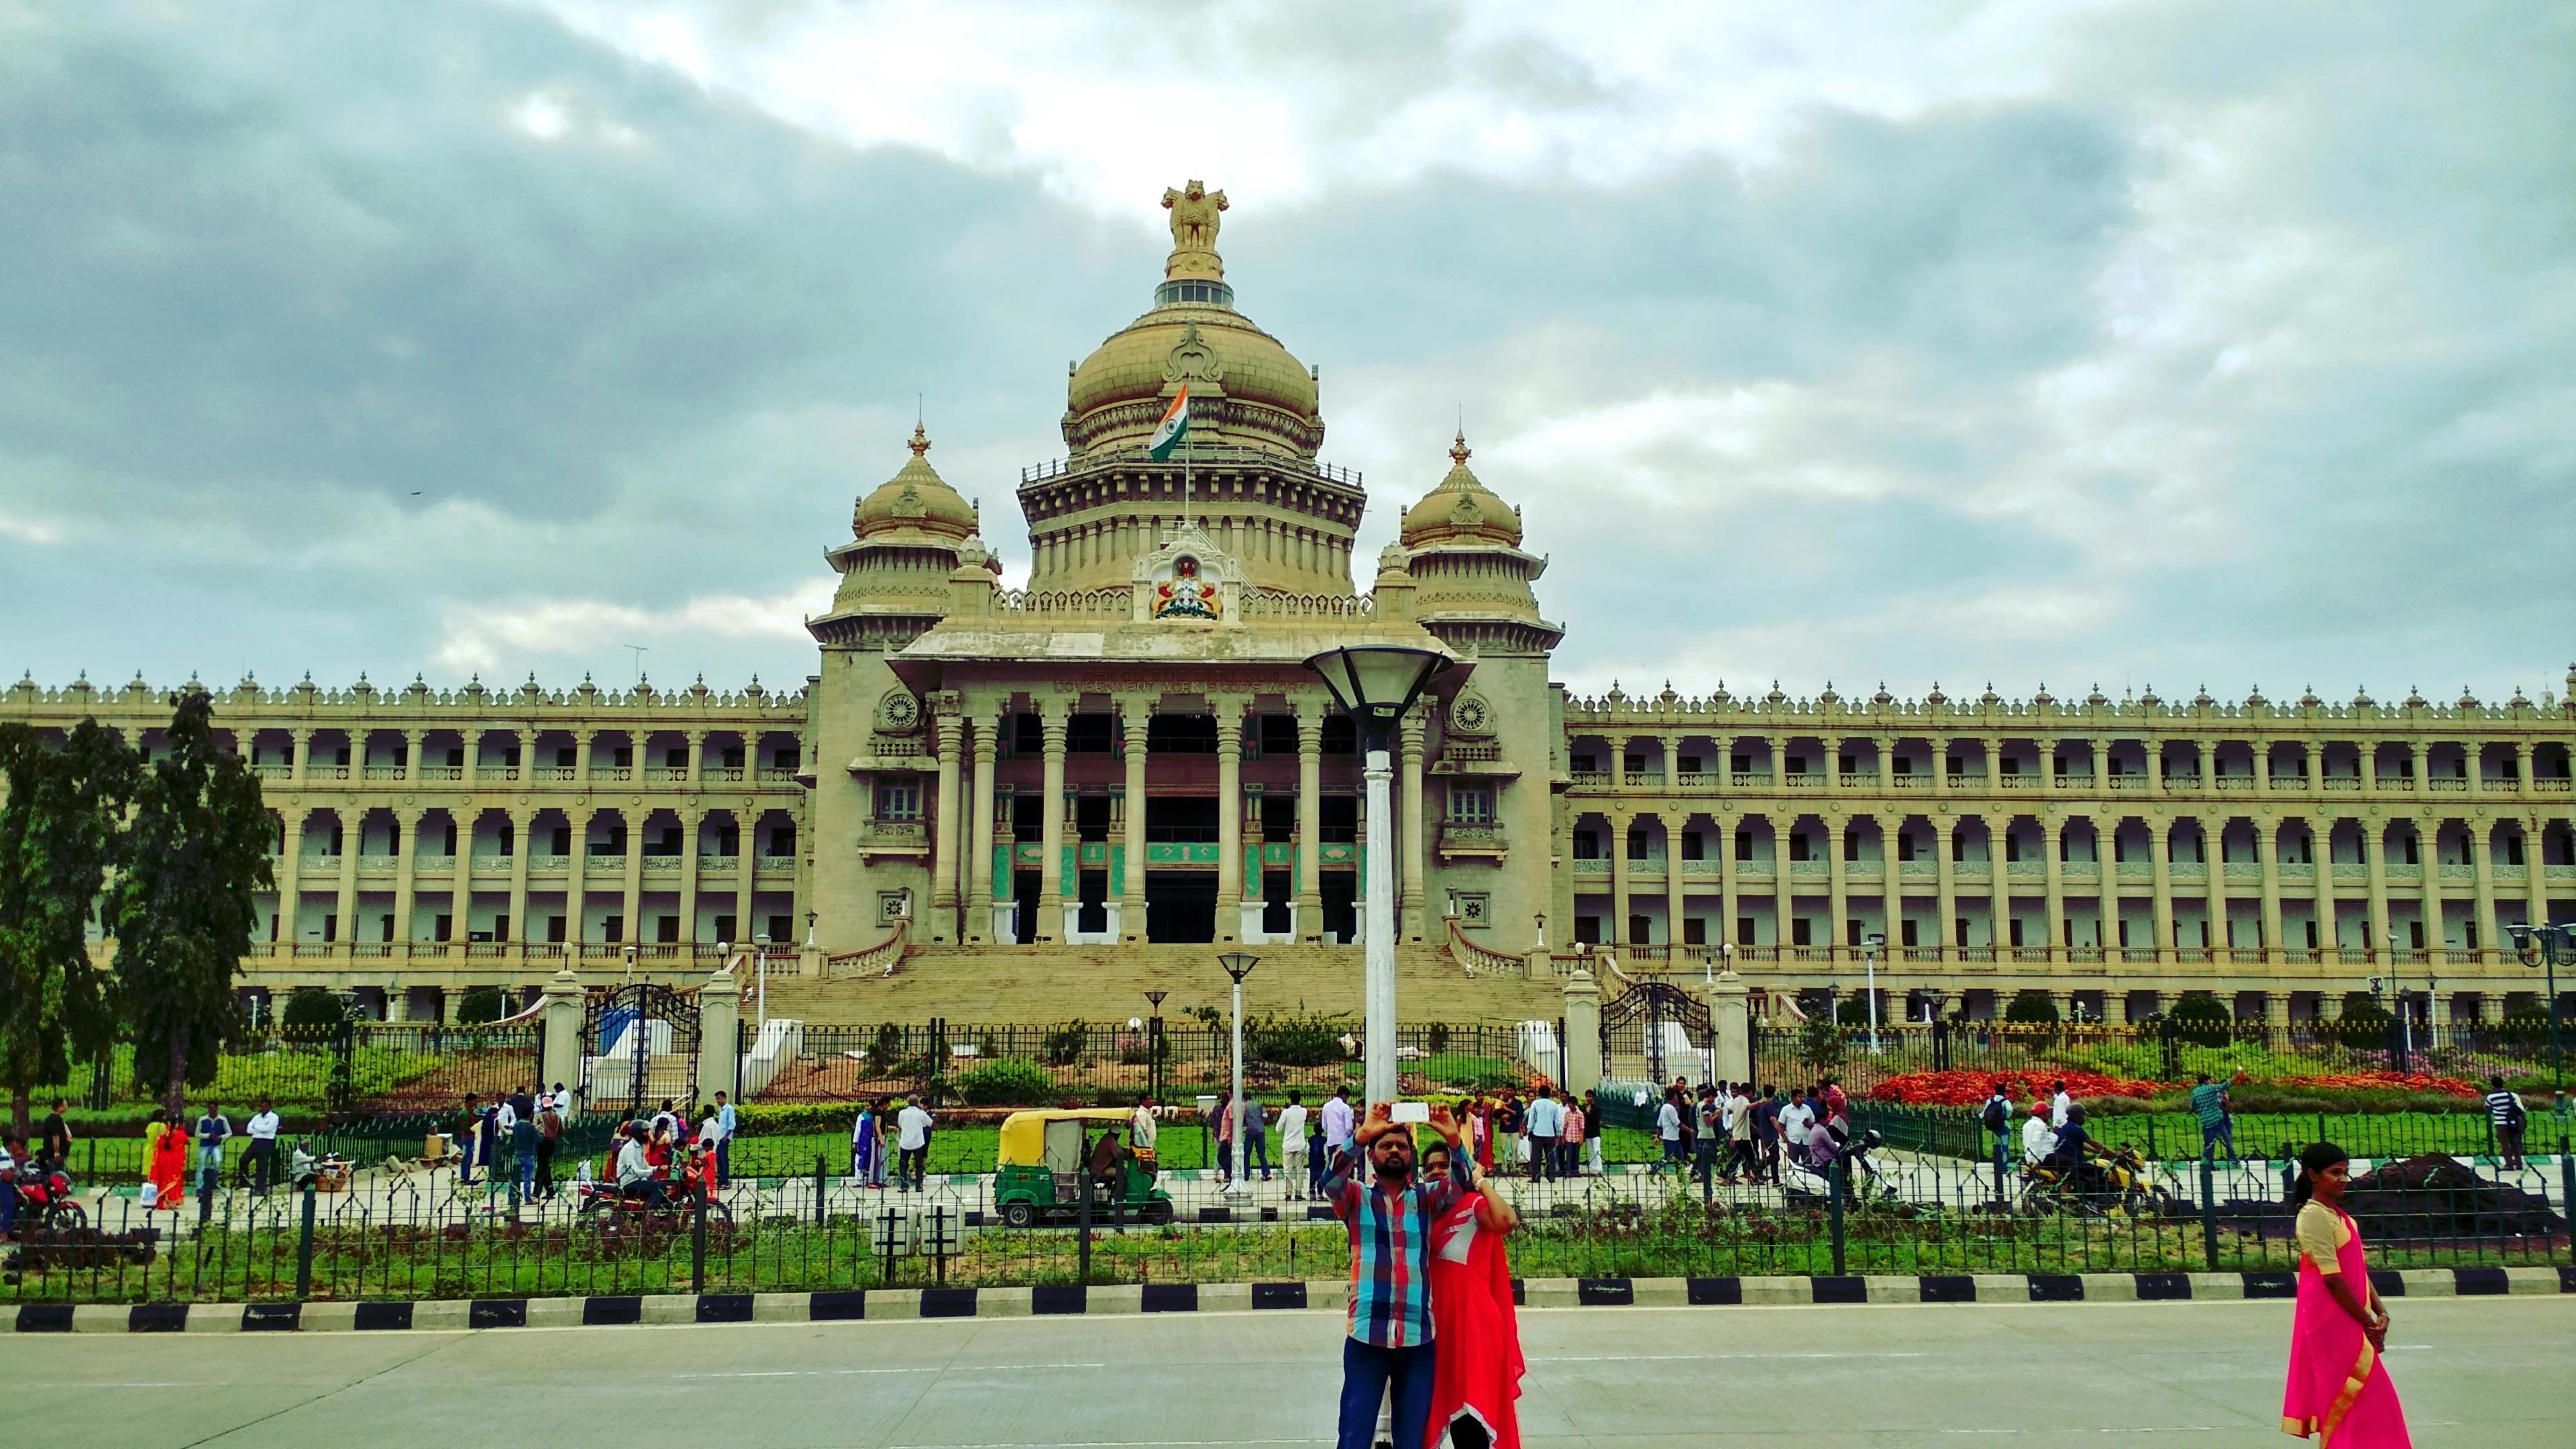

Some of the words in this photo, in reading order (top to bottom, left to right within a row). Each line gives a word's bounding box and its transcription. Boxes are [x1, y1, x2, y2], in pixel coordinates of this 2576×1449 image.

[1161, 681, 1201, 692] WORK
[1204, 682, 1218, 693] IS
[1267, 682, 1307, 693] WORK
